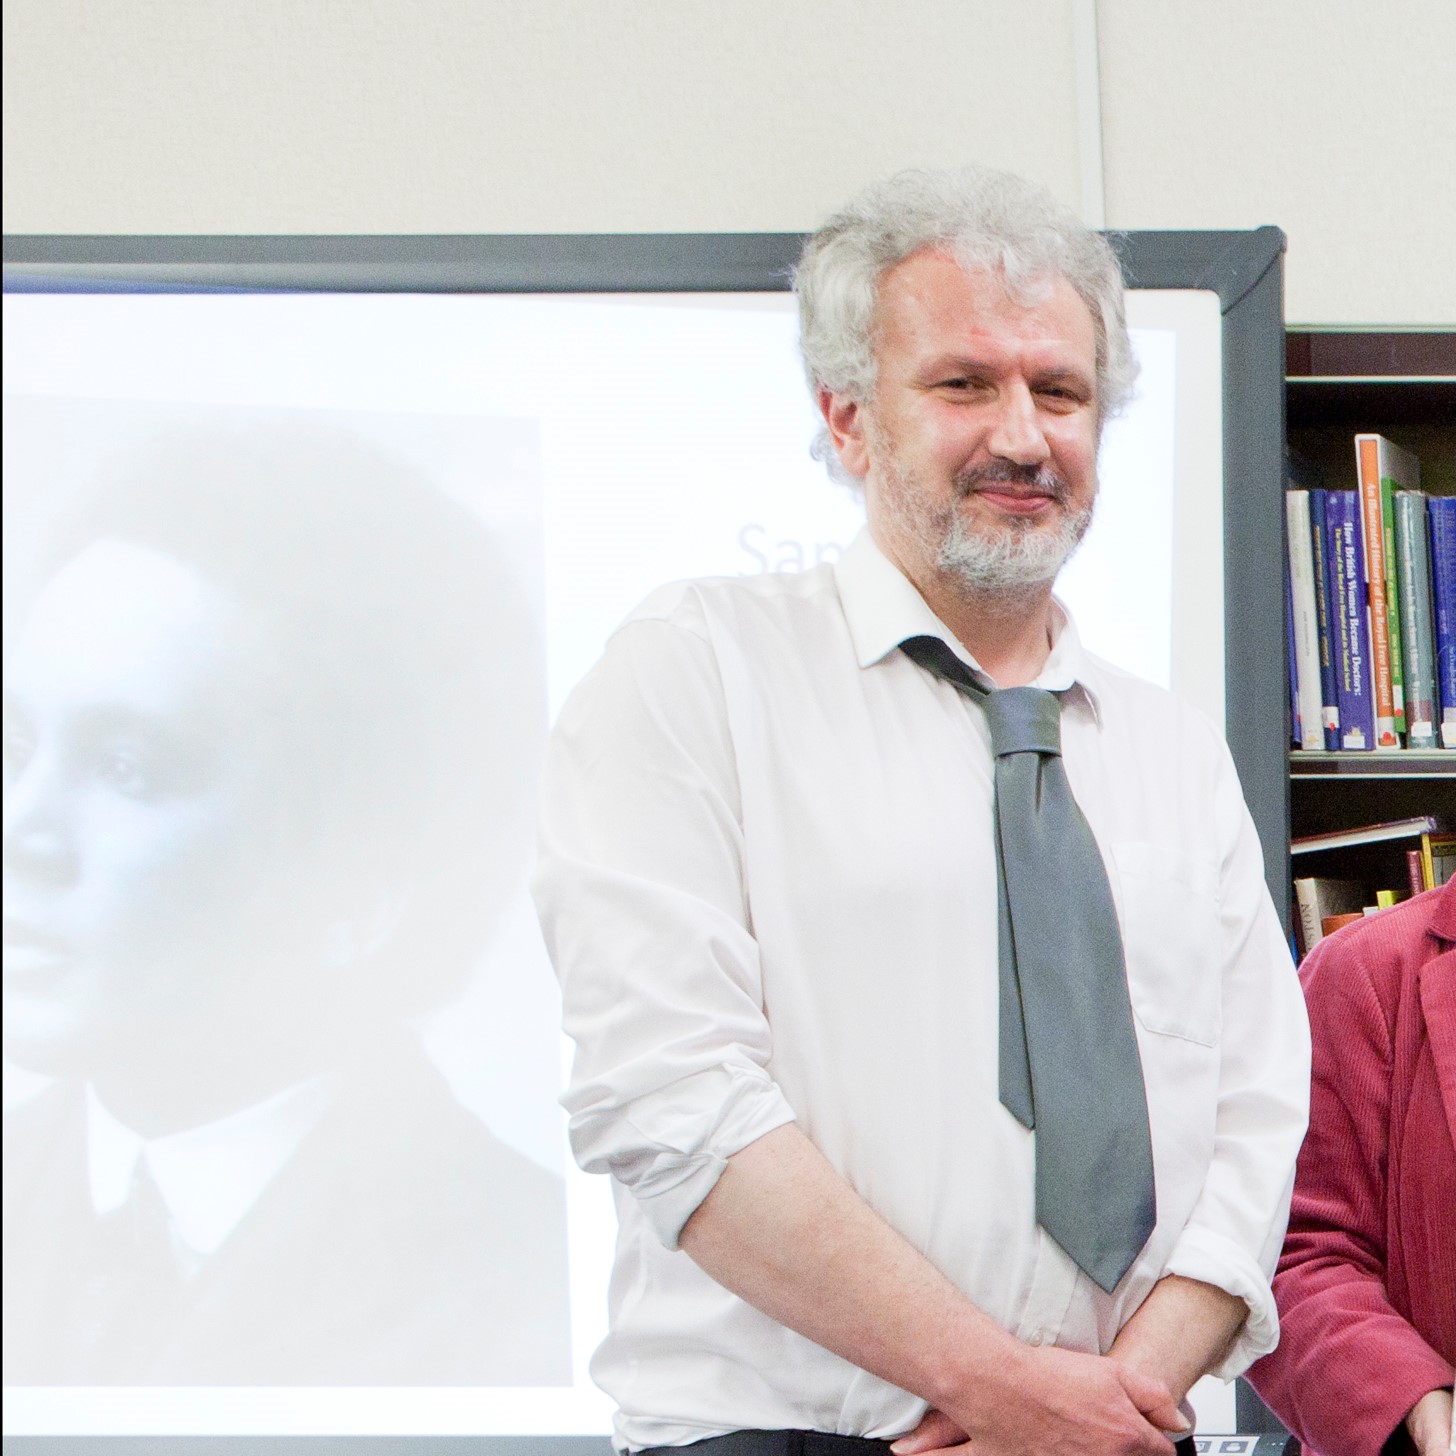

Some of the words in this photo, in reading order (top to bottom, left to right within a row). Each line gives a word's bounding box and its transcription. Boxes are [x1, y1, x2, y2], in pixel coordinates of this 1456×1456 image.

[1366, 483, 1377, 497] An
[1344, 522, 1356, 545] How
[1367, 499, 1380, 549] Illustrated
[1345, 546, 1358, 578] British
[1370, 549, 1383, 584] History
[1347, 580, 1360, 617] Women
[1373, 586, 1384, 597] of
[1373, 598, 1385, 614] the
[1349, 619, 1362, 655] Became
[1375, 616, 1387, 642] Royal
[1376, 644, 1388, 665] Free
[1351, 656, 1364, 696] Doctors:
[1378, 666, 1391, 706] Hospital
